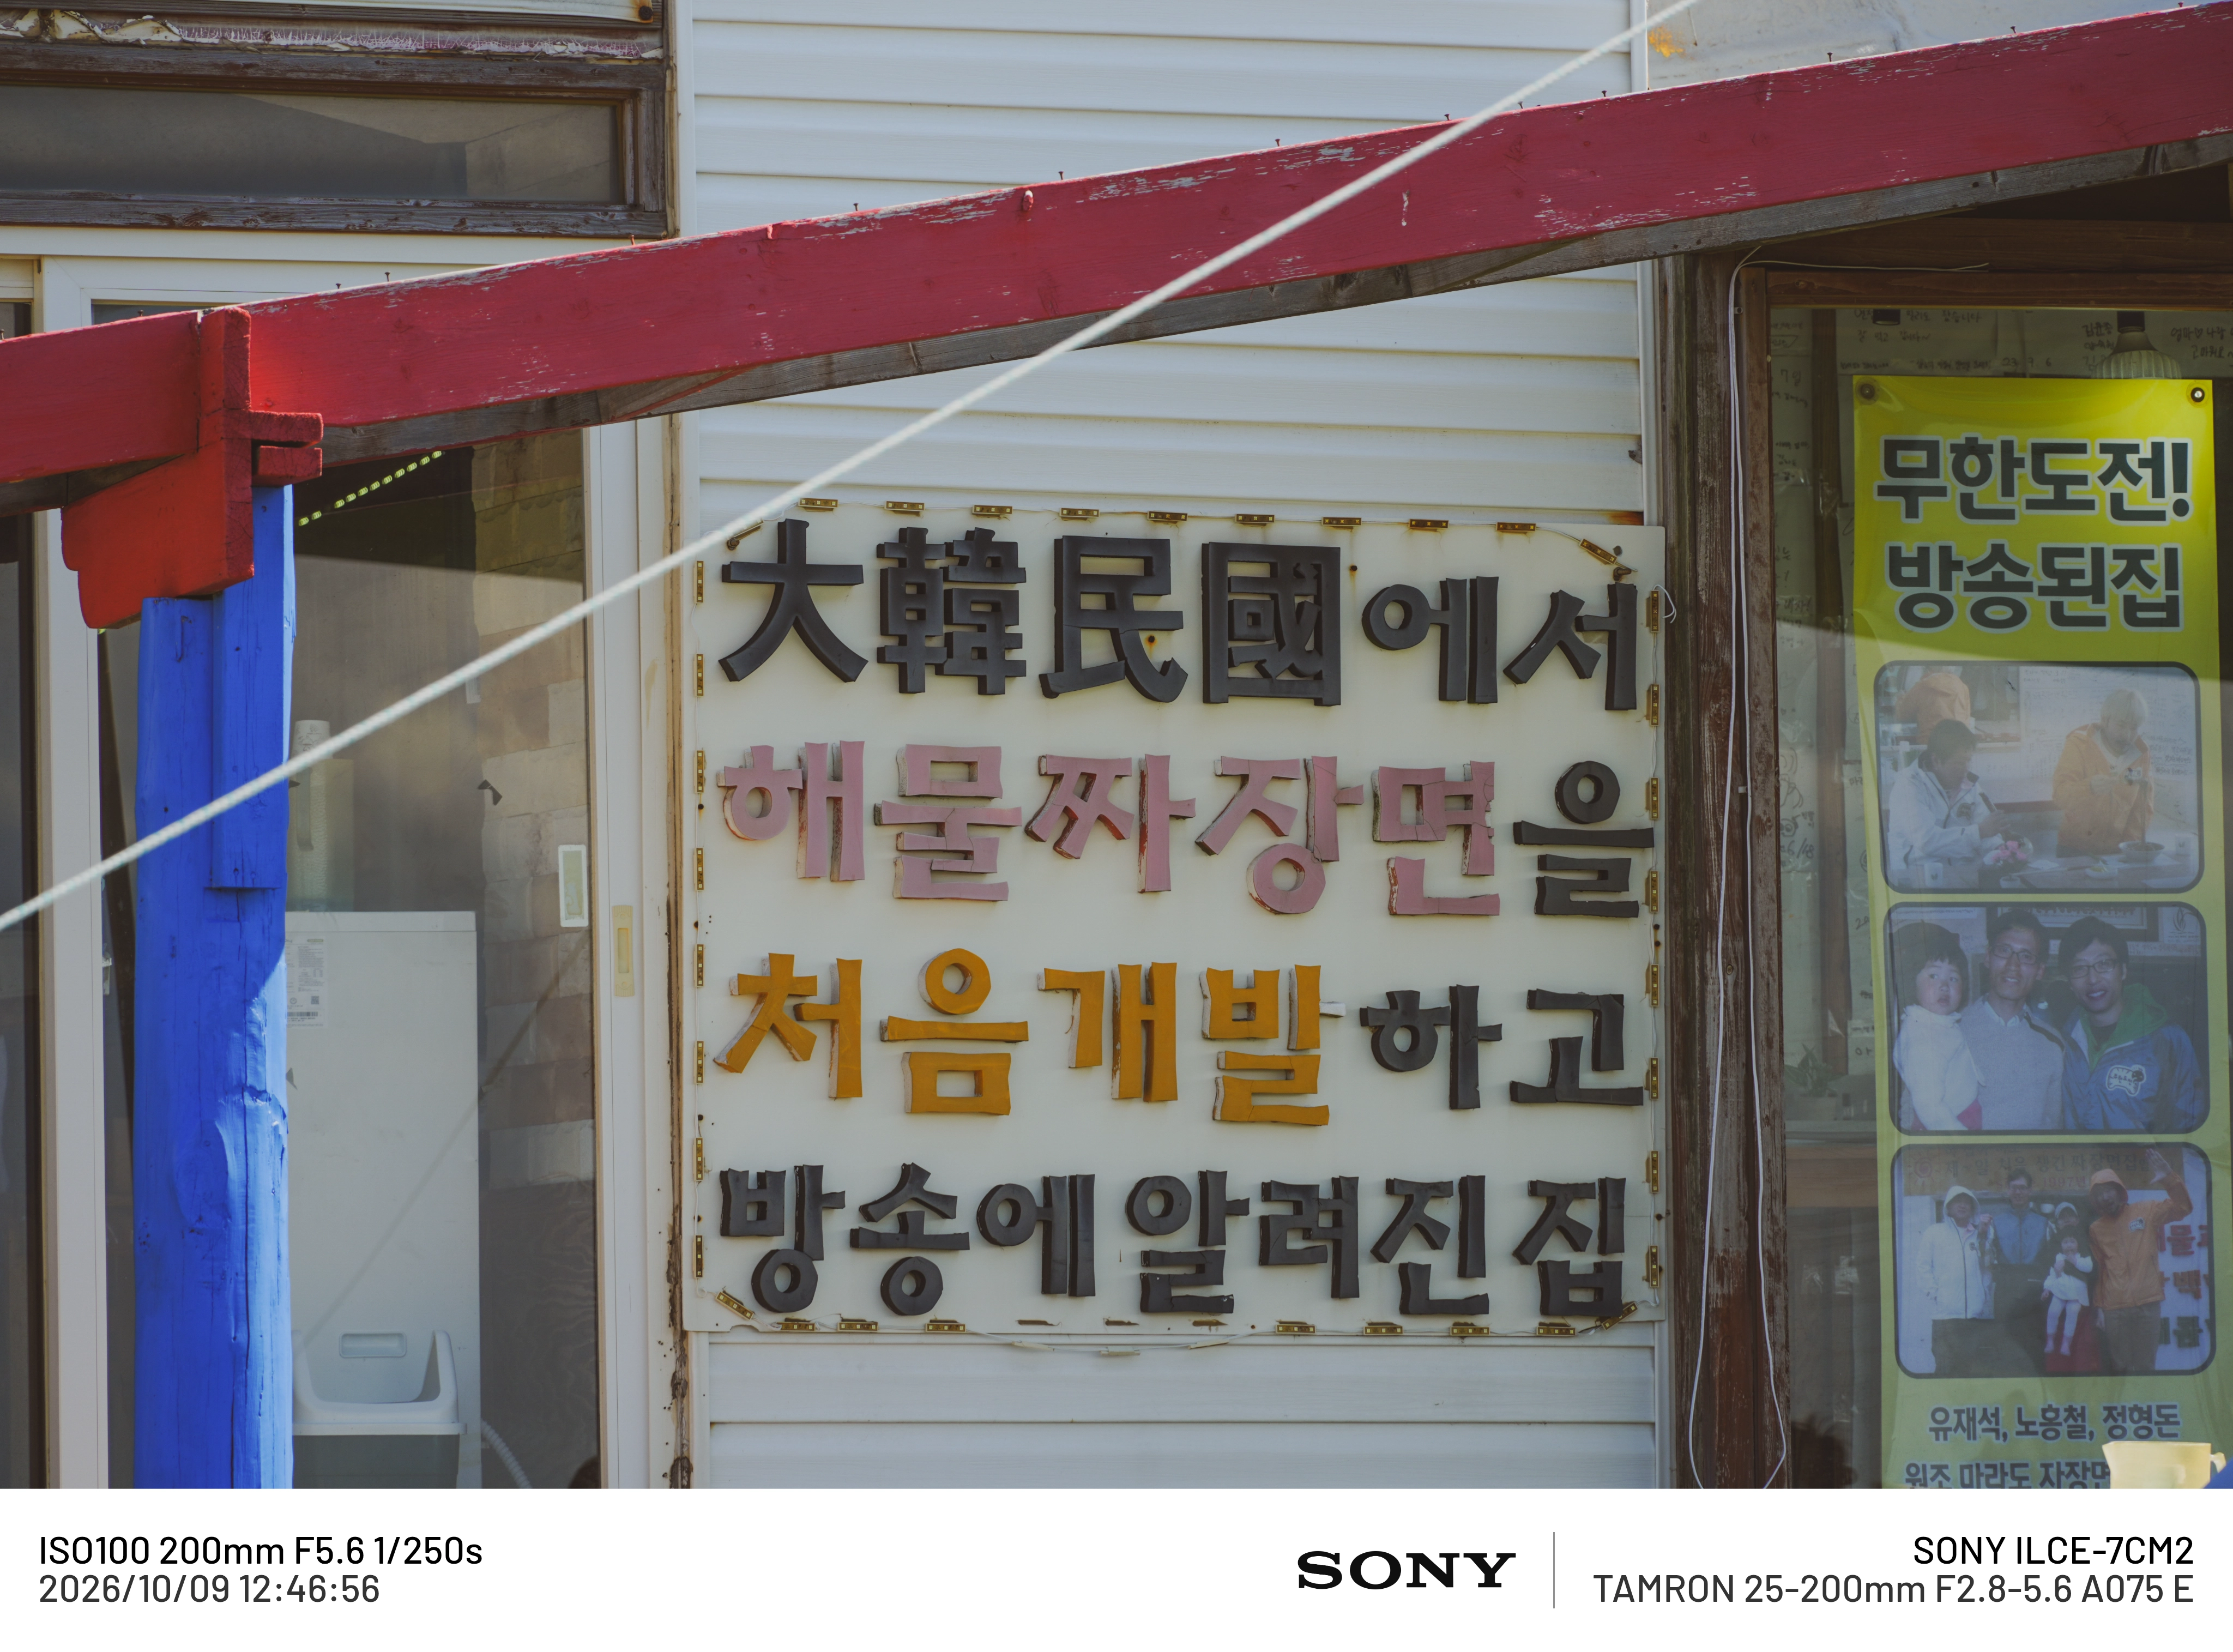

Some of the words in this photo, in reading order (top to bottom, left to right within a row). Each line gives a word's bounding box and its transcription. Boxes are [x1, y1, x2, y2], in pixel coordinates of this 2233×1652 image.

[1876, 436, 2191, 521] 무한도전!
[719, 518, 1638, 710] 大韓民國에서
[1888, 543, 2181, 629] 방송된집
[717, 740, 1655, 918] 해물짜장면을
[1928, 1406, 2009, 1443] 유재석,
[2015, 1404, 2095, 1442] 노홍철,
[2102, 1403, 2181, 1440] 정형돈
[1905, 1462, 1952, 1489] 원조
[1959, 1462, 2032, 1489] 마라도
